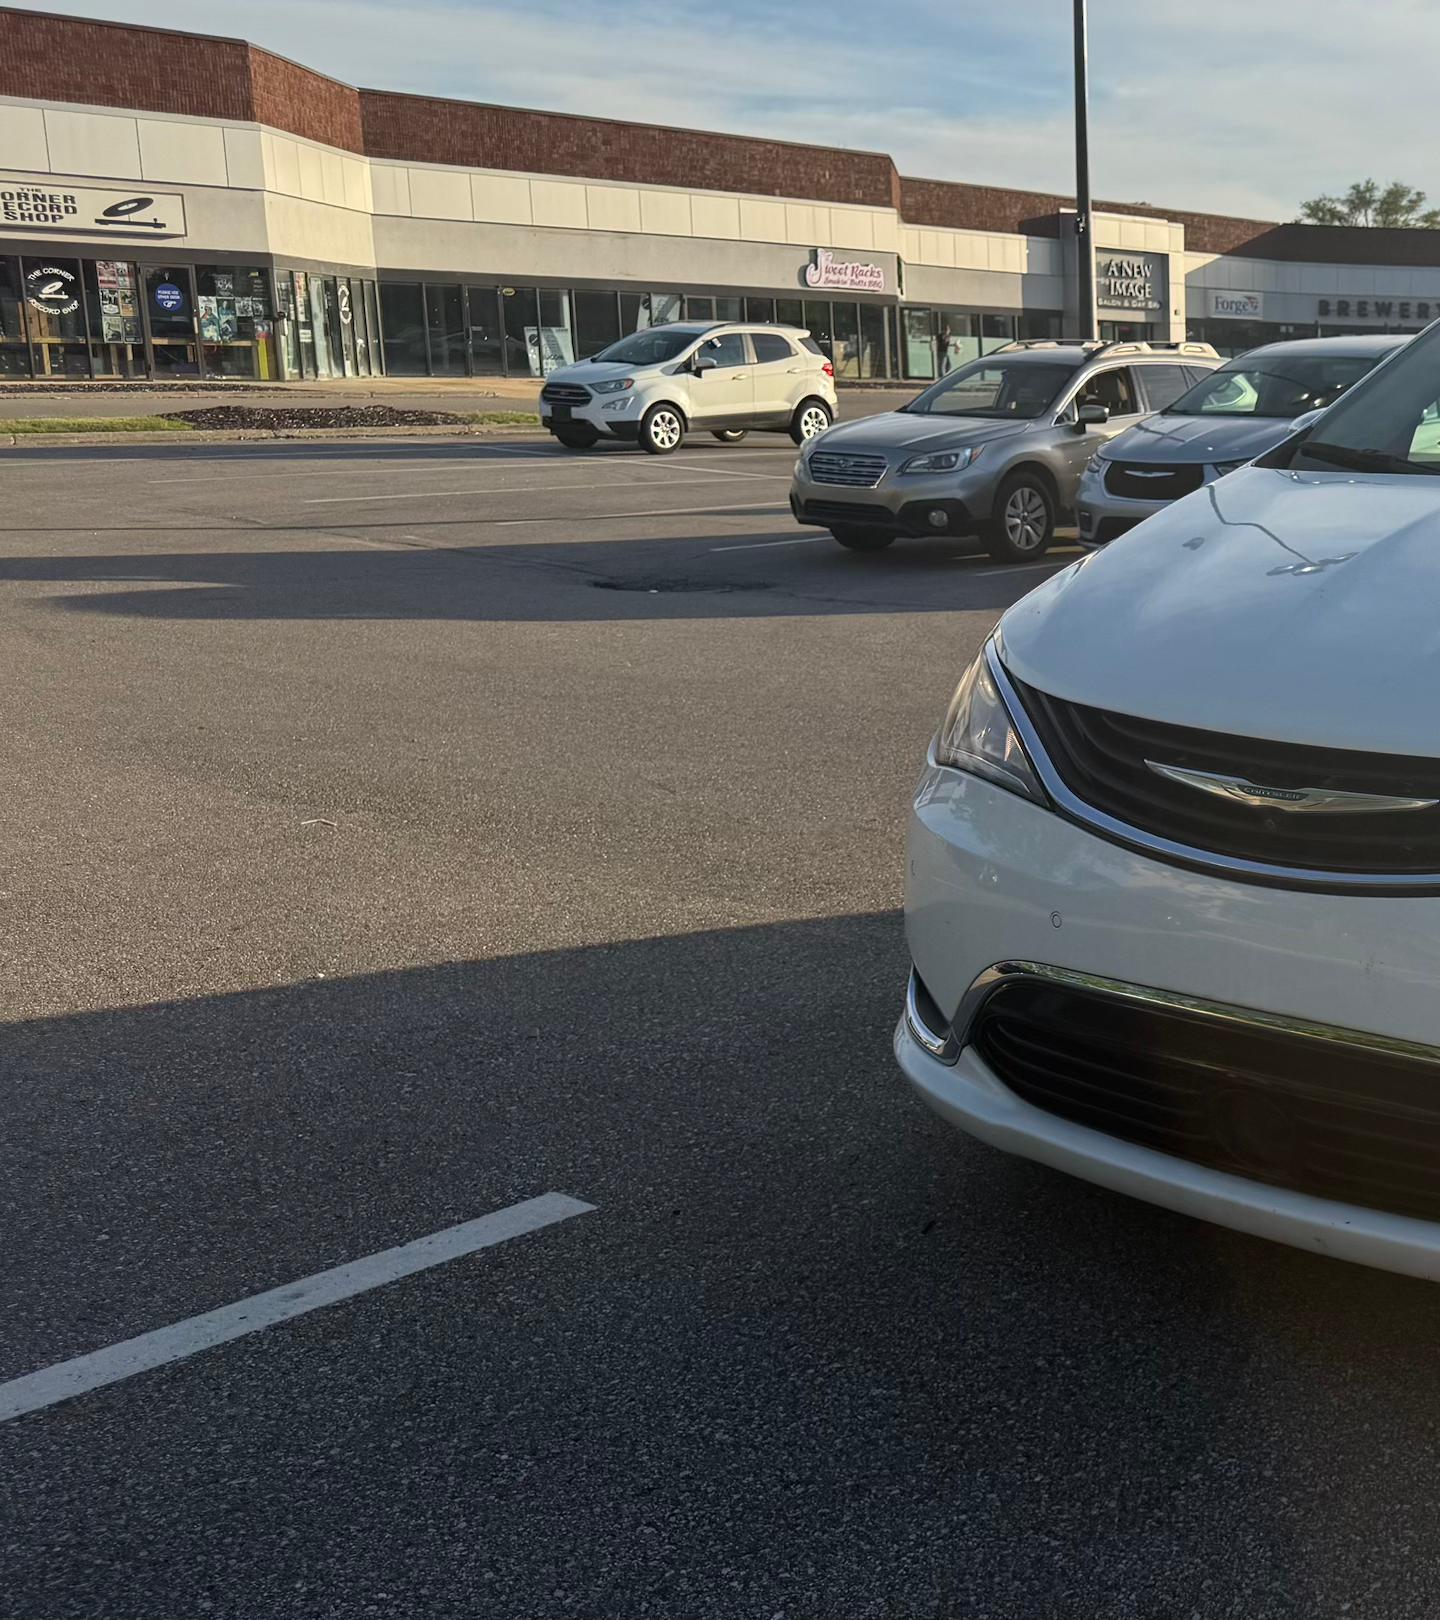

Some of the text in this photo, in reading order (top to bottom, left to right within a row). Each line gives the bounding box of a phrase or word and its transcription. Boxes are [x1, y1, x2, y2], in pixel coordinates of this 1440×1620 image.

[4, 211, 64, 223] SHOP
[42, 267, 75, 281] CORNER
[850, 265, 881, 278] Racks
[1108, 259, 1152, 278] A NEW
[1109, 279, 1152, 298] IMAGE
[62, 300, 79, 314] SHOP
